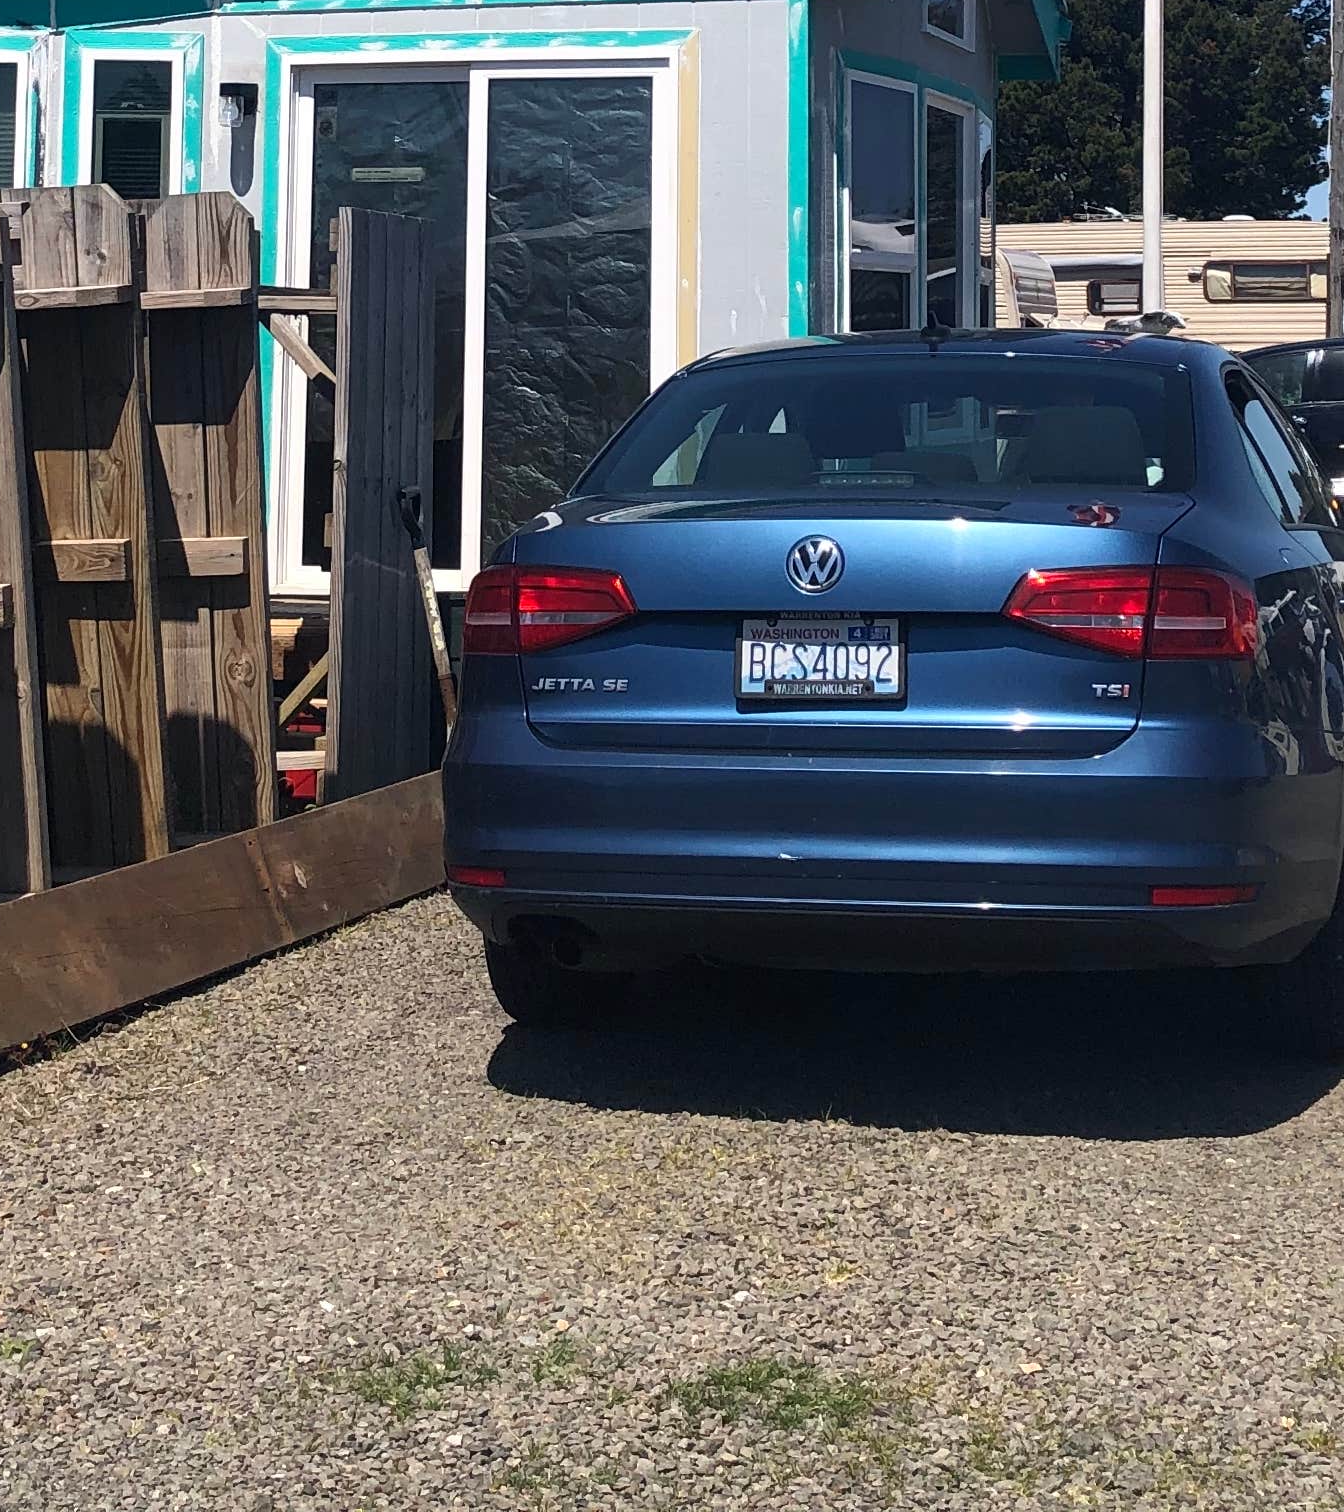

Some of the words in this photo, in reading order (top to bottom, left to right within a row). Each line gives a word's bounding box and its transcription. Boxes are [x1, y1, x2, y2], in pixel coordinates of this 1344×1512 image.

[780, 611, 842, 619] WARRENTON
[843, 611, 861, 619] KIA
[751, 628, 840, 639] WASHINGTON
[749, 642, 893, 683] BCS4092
[531, 678, 596, 690] JETTA
[602, 679, 629, 691] SE
[773, 683, 864, 695] WARRENTONKIA.NET
[1091, 684, 1130, 698] TSI
